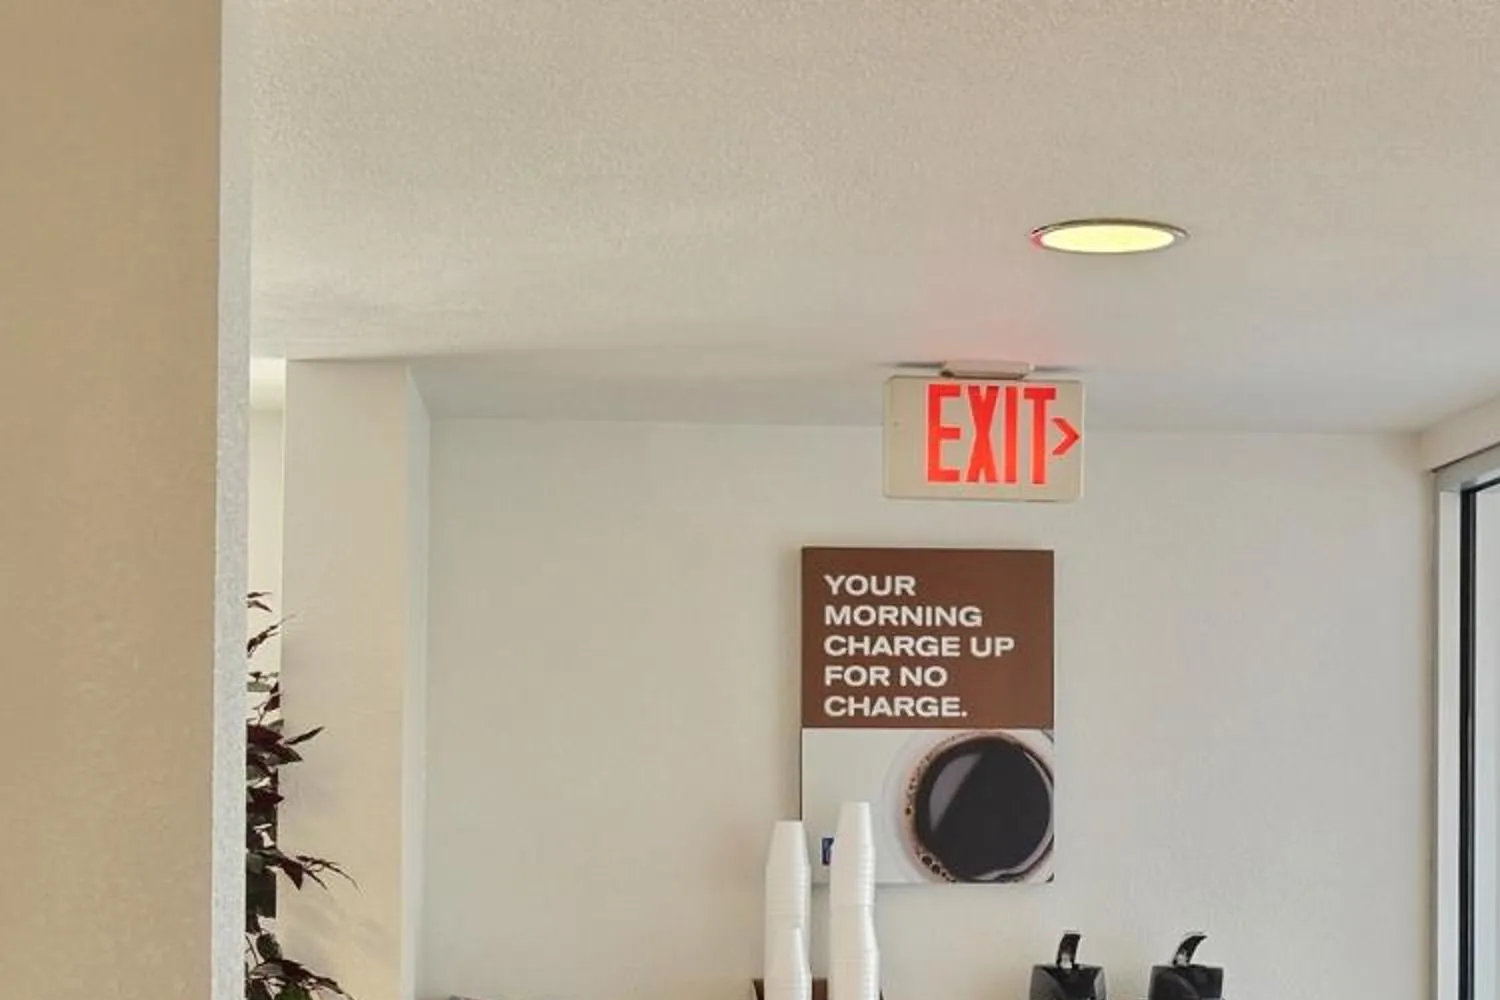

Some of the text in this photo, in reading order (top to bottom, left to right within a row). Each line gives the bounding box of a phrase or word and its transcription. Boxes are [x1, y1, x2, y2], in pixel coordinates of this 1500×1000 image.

[926, 383, 1057, 484] EXIT
[823, 574, 916, 597] YOUR
[824, 605, 983, 627] MORNING
[823, 635, 1015, 658] CHARGE UP
[824, 665, 948, 687] FOR NO
[823, 695, 968, 718] CHARGE.
